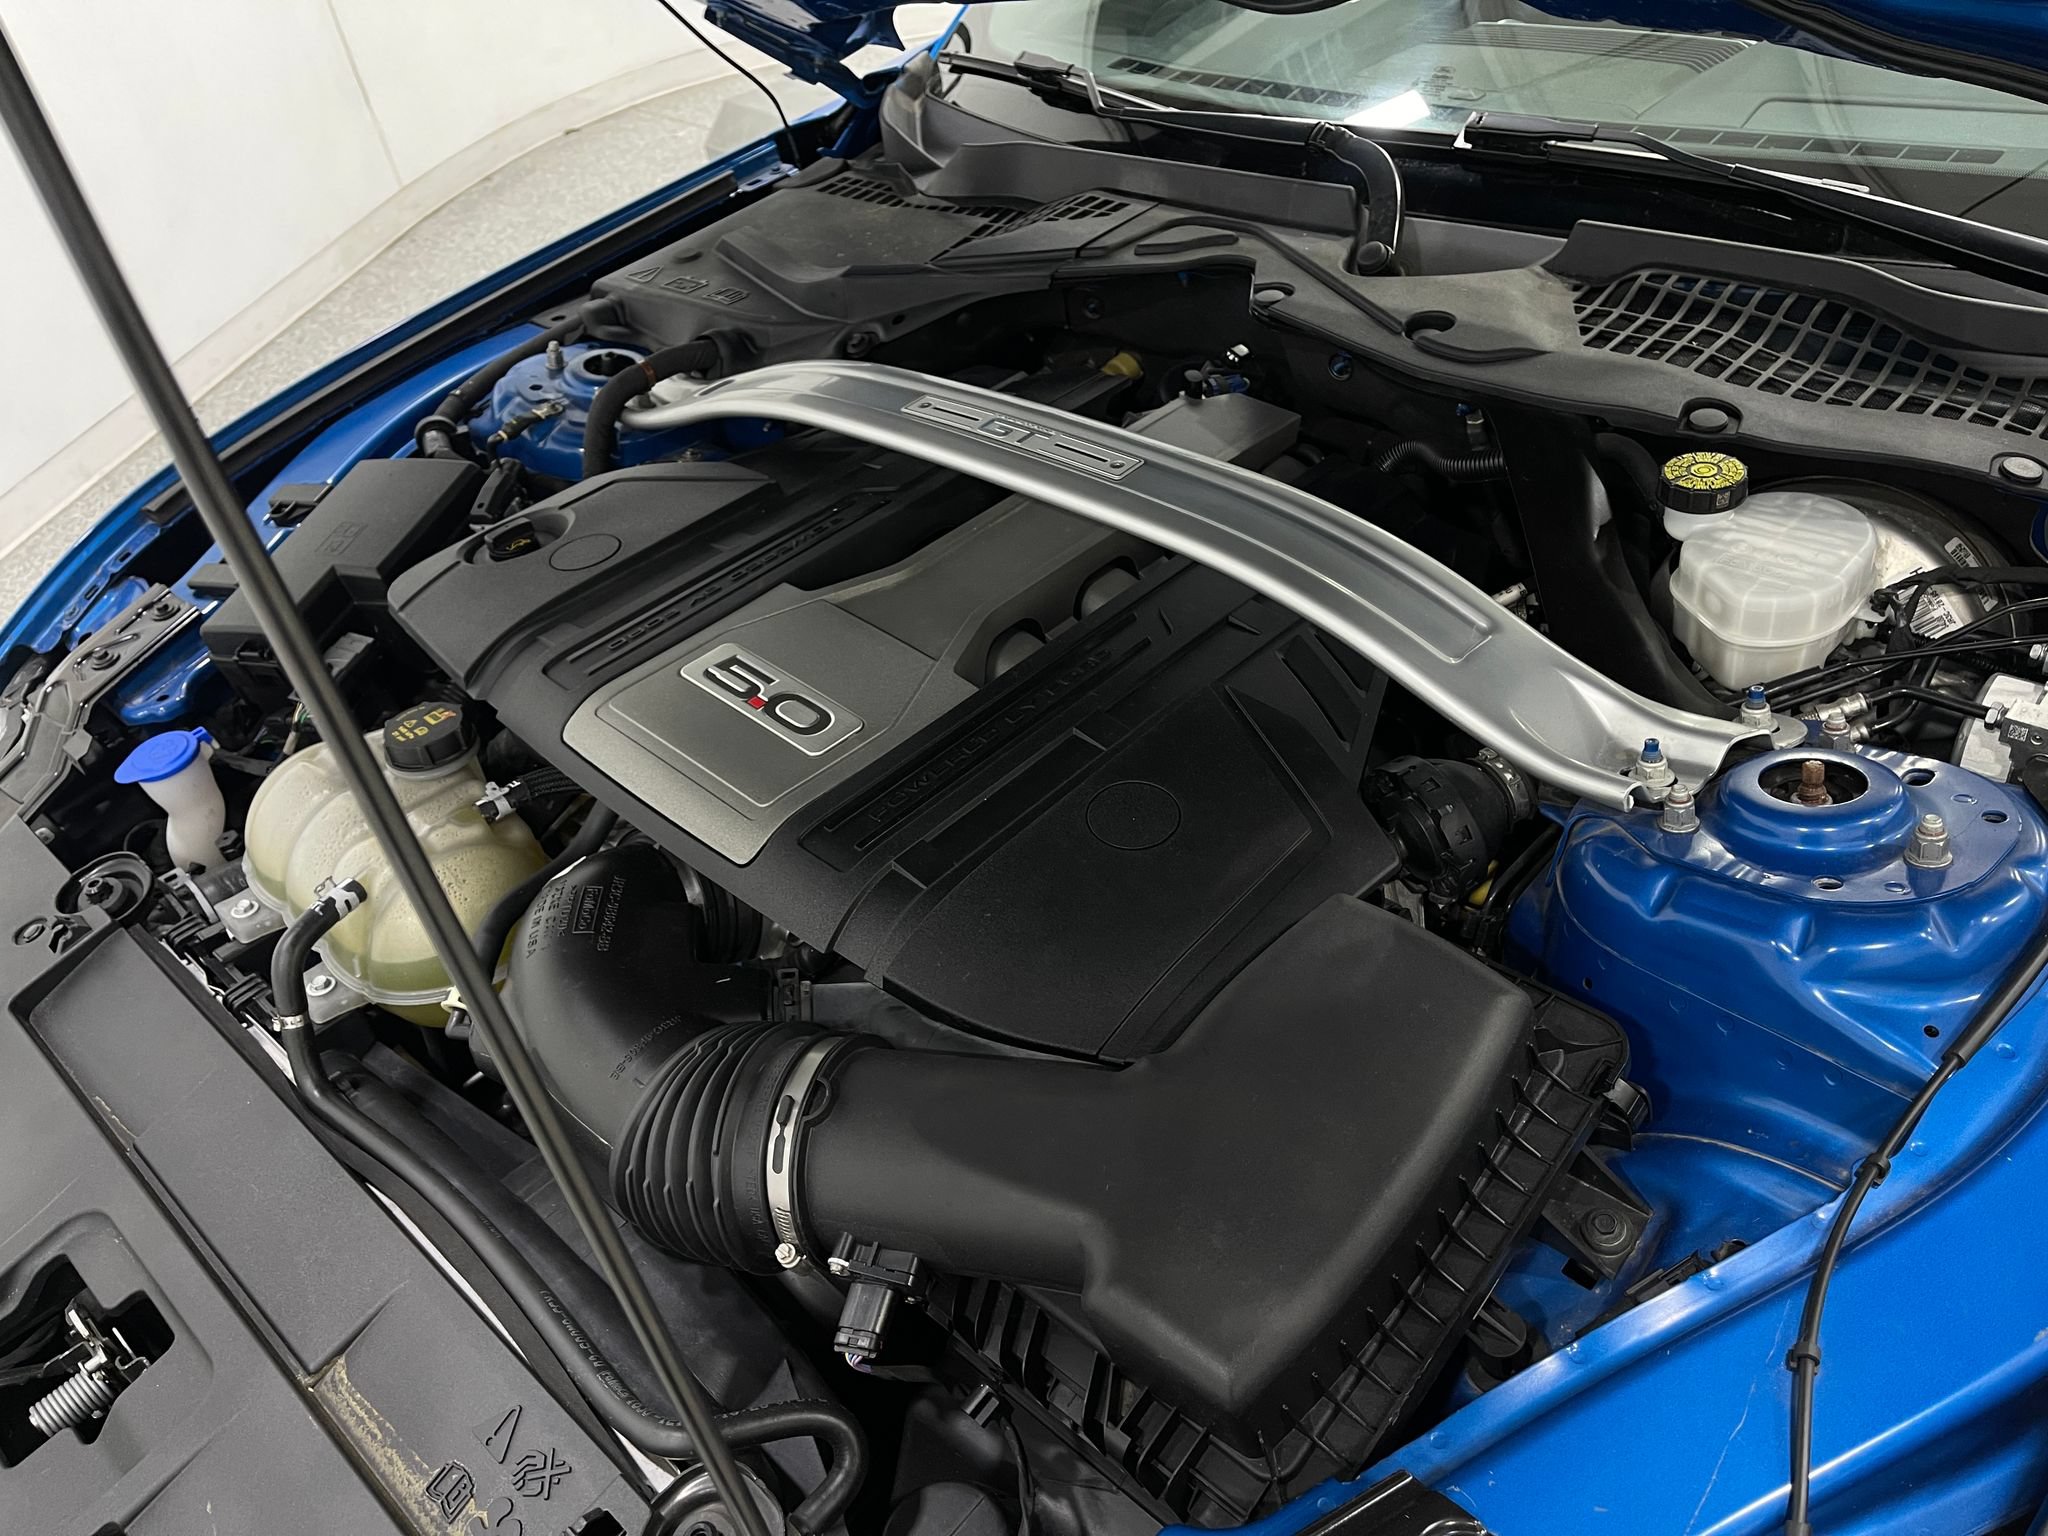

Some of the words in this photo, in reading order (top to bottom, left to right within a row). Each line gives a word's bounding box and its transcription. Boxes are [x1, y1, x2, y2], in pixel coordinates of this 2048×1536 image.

[979, 417, 1054, 445] GT
[607, 607, 681, 652] FORD
[703, 655, 834, 738] 5.0
[577, 887, 599, 931] FoMoCo
[525, 929, 540, 959] USA
